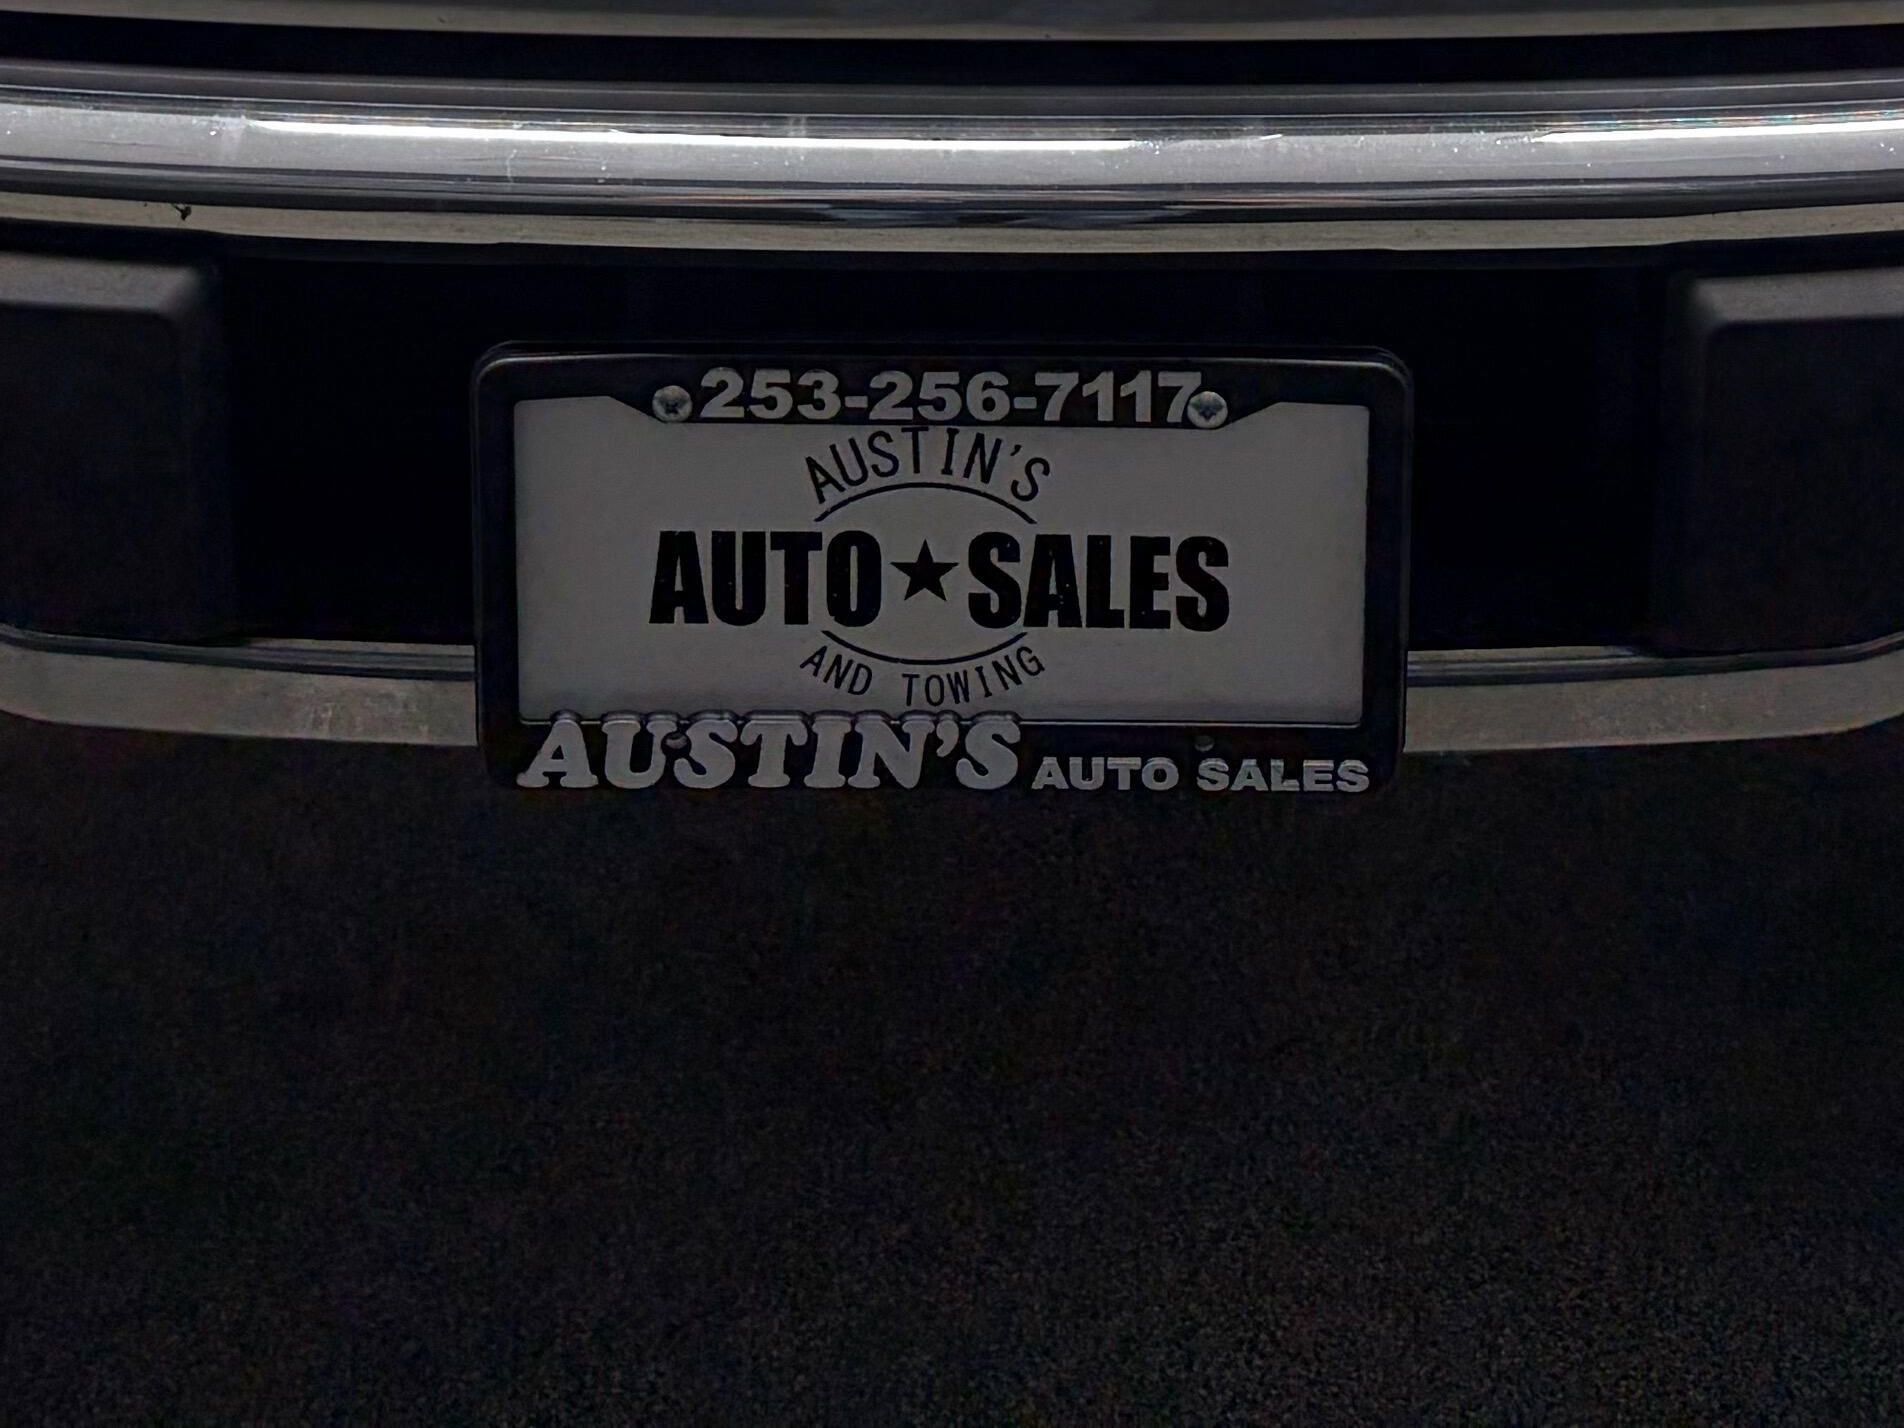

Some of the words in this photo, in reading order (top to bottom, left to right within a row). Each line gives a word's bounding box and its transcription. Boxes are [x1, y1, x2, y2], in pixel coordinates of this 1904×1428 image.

[699, 365, 1203, 422] 253-256-7117
[803, 426, 1051, 504] AUSTIN'S
[648, 530, 883, 627] AUTO
[967, 532, 1230, 633] SALES
[799, 645, 874, 697] AND
[903, 644, 1046, 708] TOWING
[517, 713, 1023, 790] AUSTIN'S
[1031, 756, 1180, 792] AUTO
[1195, 757, 1371, 794] SALES
